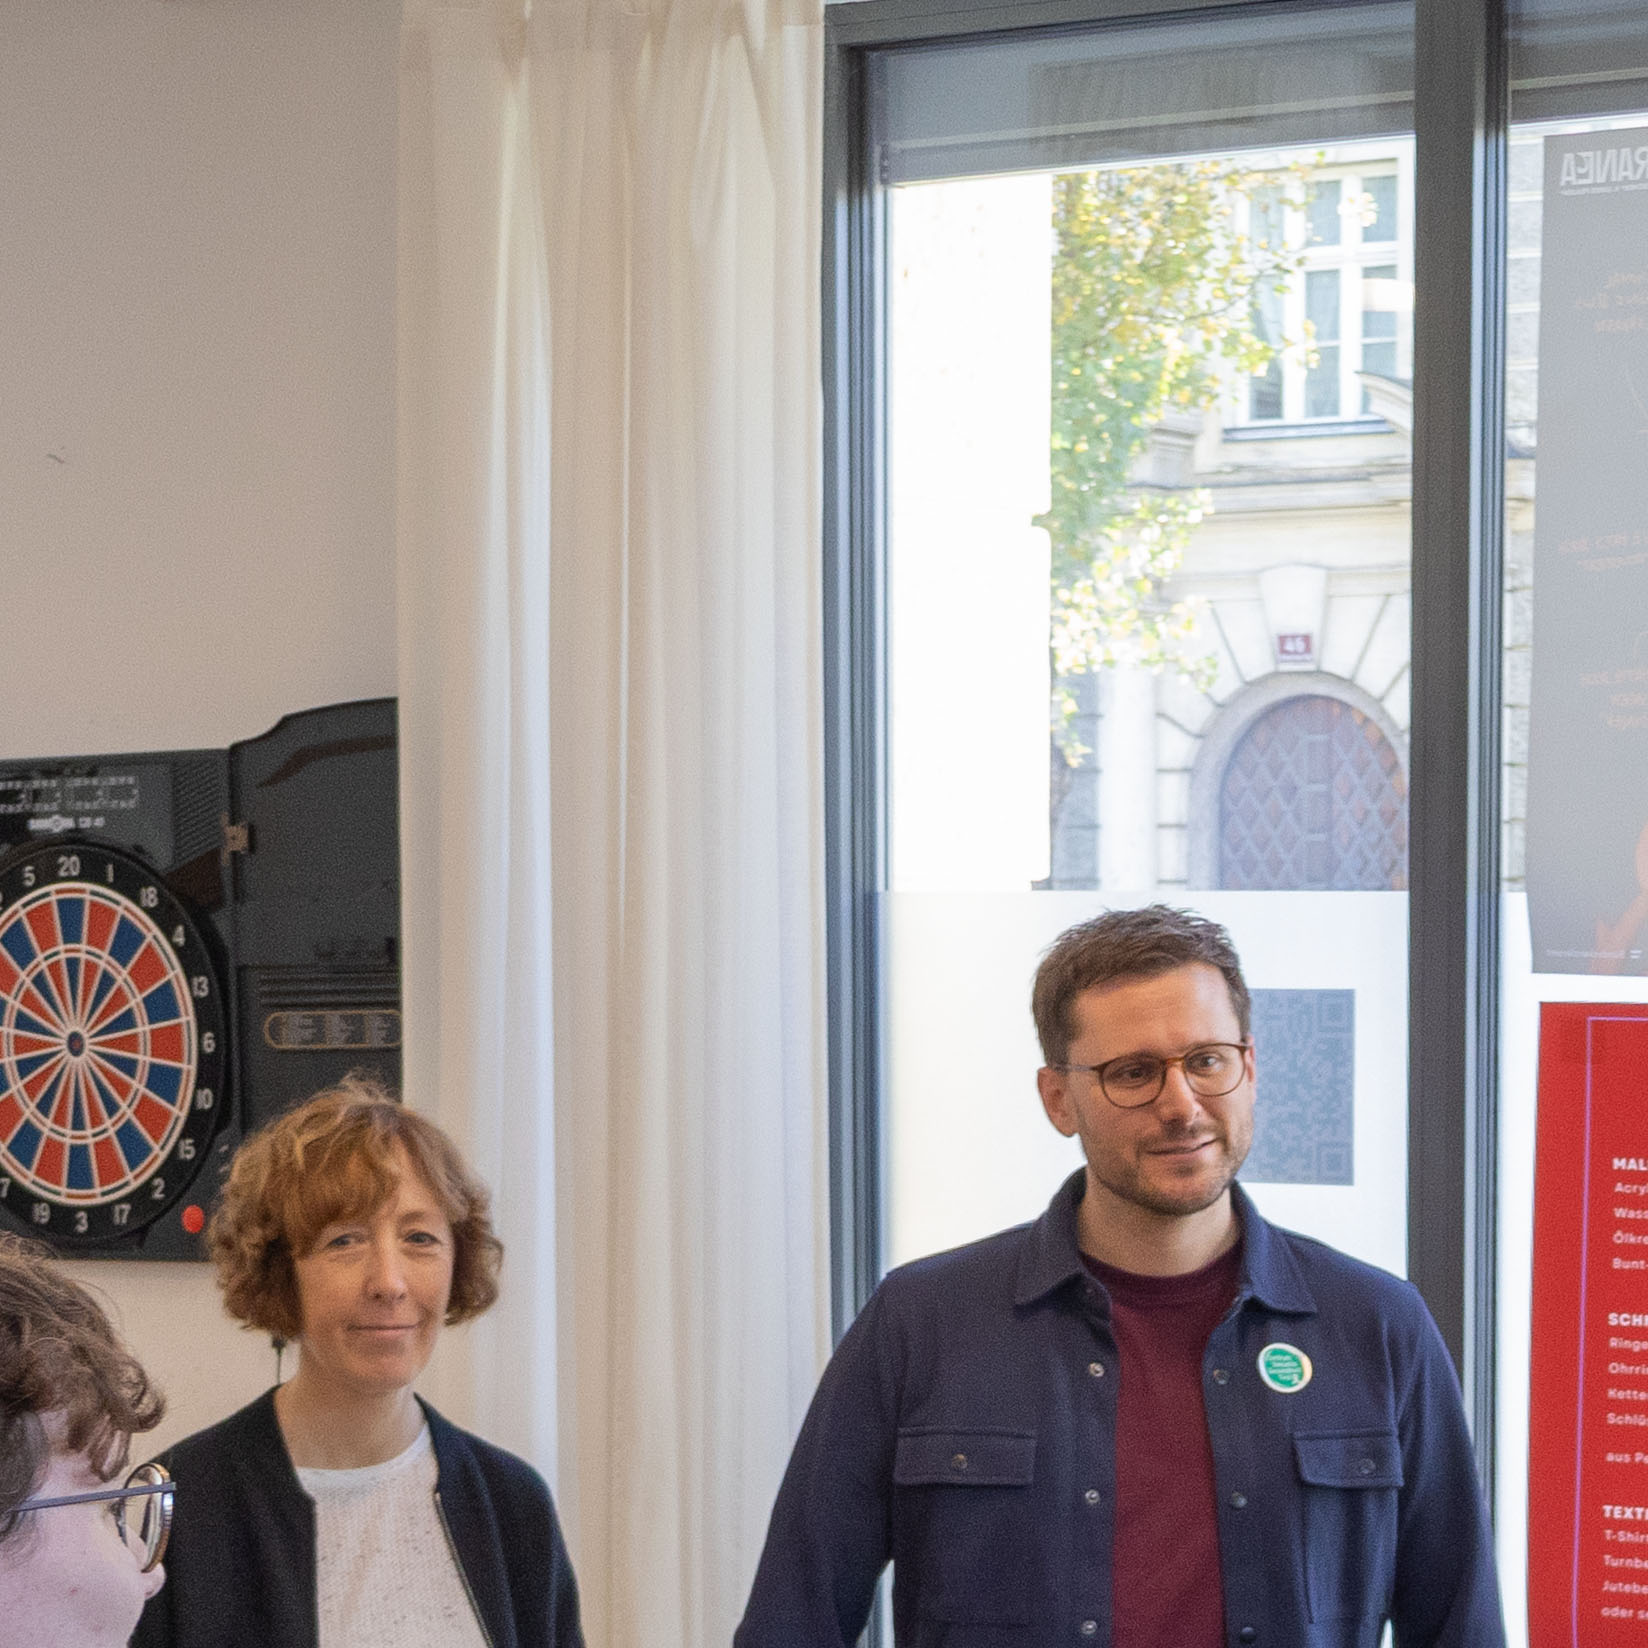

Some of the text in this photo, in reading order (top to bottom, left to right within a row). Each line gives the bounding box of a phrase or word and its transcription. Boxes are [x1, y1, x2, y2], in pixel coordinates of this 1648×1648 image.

[24, 865, 35, 886] 5
[58, 855, 80, 877] 20
[107, 864, 114, 883] 1
[141, 886, 158, 908] 18
[172, 925, 185, 946] 4
[192, 976, 209, 997] 13
[203, 1033, 214, 1053] 6
[196, 1088, 213, 1109] 10
[179, 1139, 195, 1160] 15
[0, 1175, 13, 1197] 7
[152, 1178, 164, 1199] 2
[34, 1202, 50, 1224] 19
[76, 1211, 88, 1233] 3
[114, 1203, 131, 1224] 17
[1606, 1453, 1631, 1463] aus
[1601, 1607, 1634, 1618] oder
